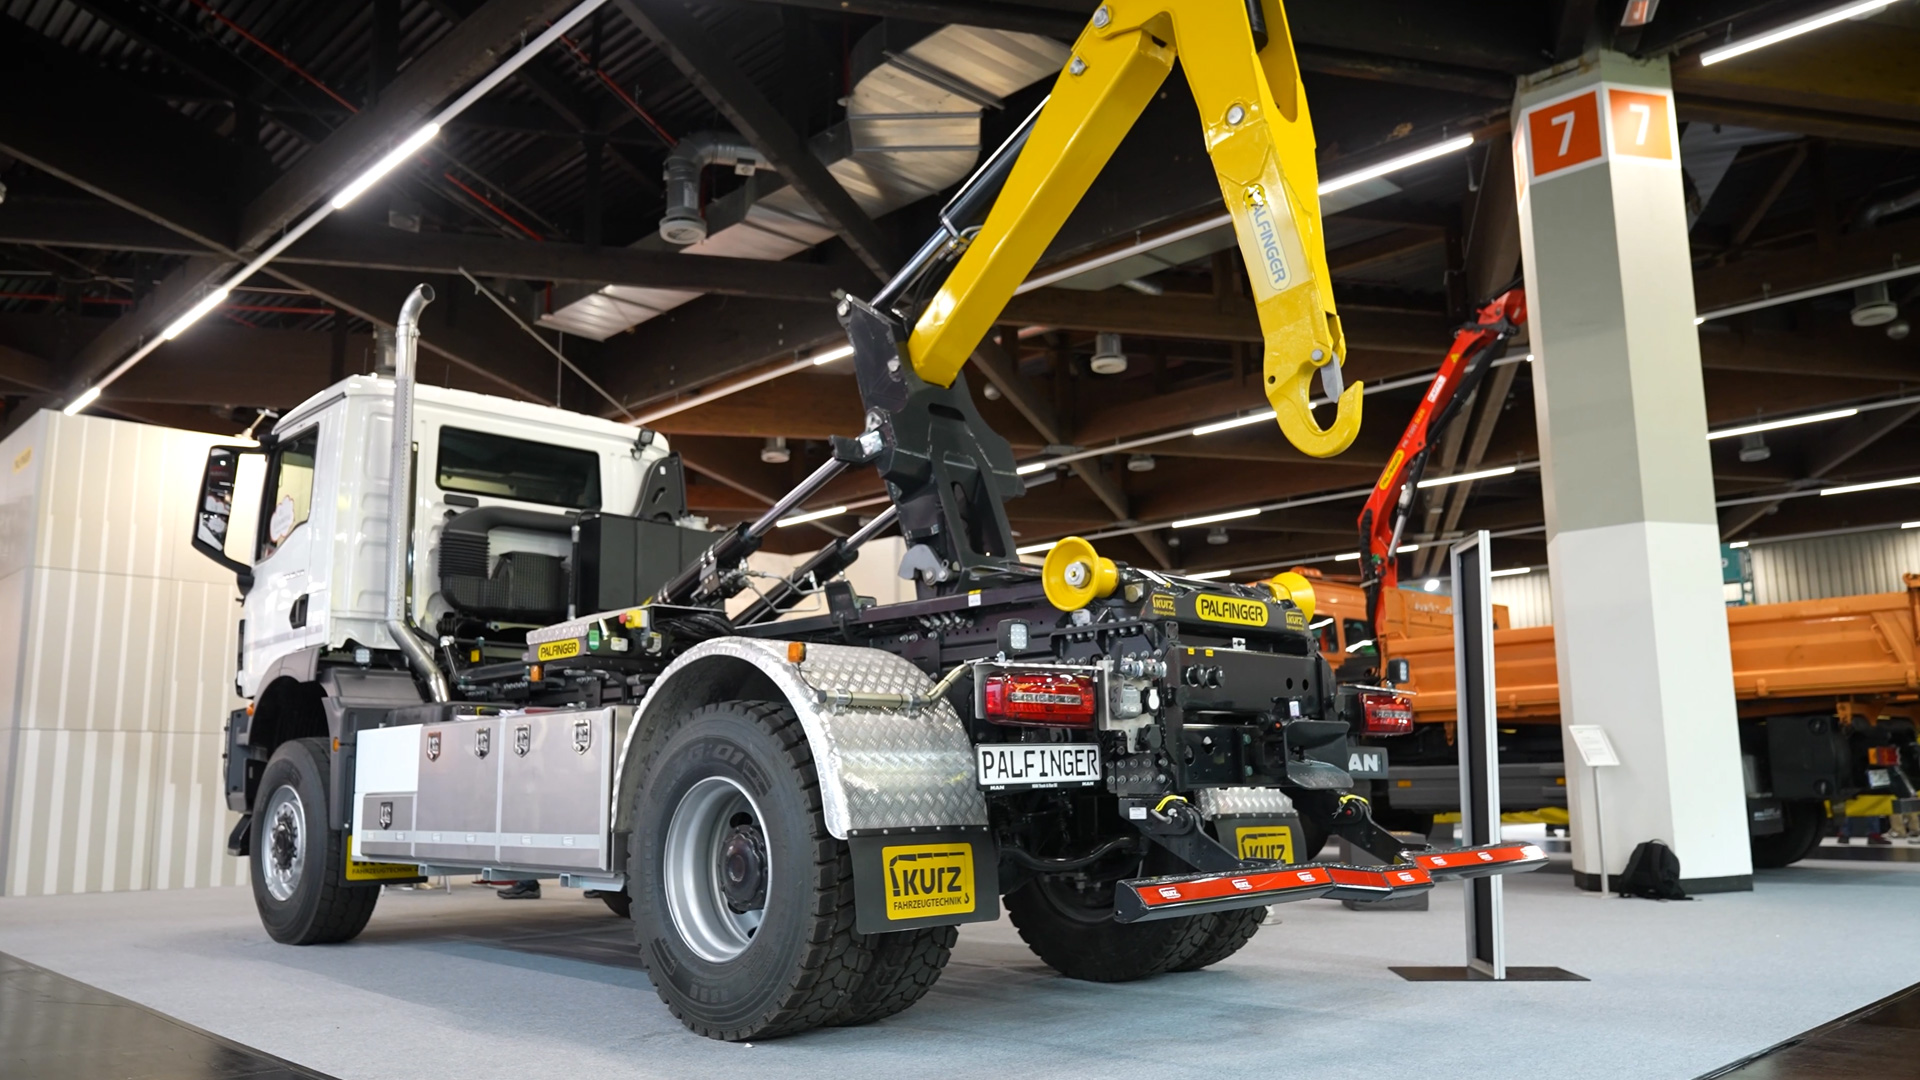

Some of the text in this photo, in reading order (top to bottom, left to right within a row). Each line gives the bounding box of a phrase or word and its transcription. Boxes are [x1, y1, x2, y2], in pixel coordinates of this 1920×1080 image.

[1551, 111, 1575, 157] 7
[1630, 104, 1650, 145] 7
[1201, 598, 1264, 622] PALFINGER
[540, 642, 577, 658] PALFINGER
[982, 749, 1098, 779] PALFINGER
[1348, 753, 1378, 771] AN
[893, 896, 962, 911] FAHRZEUGTECHNIK
